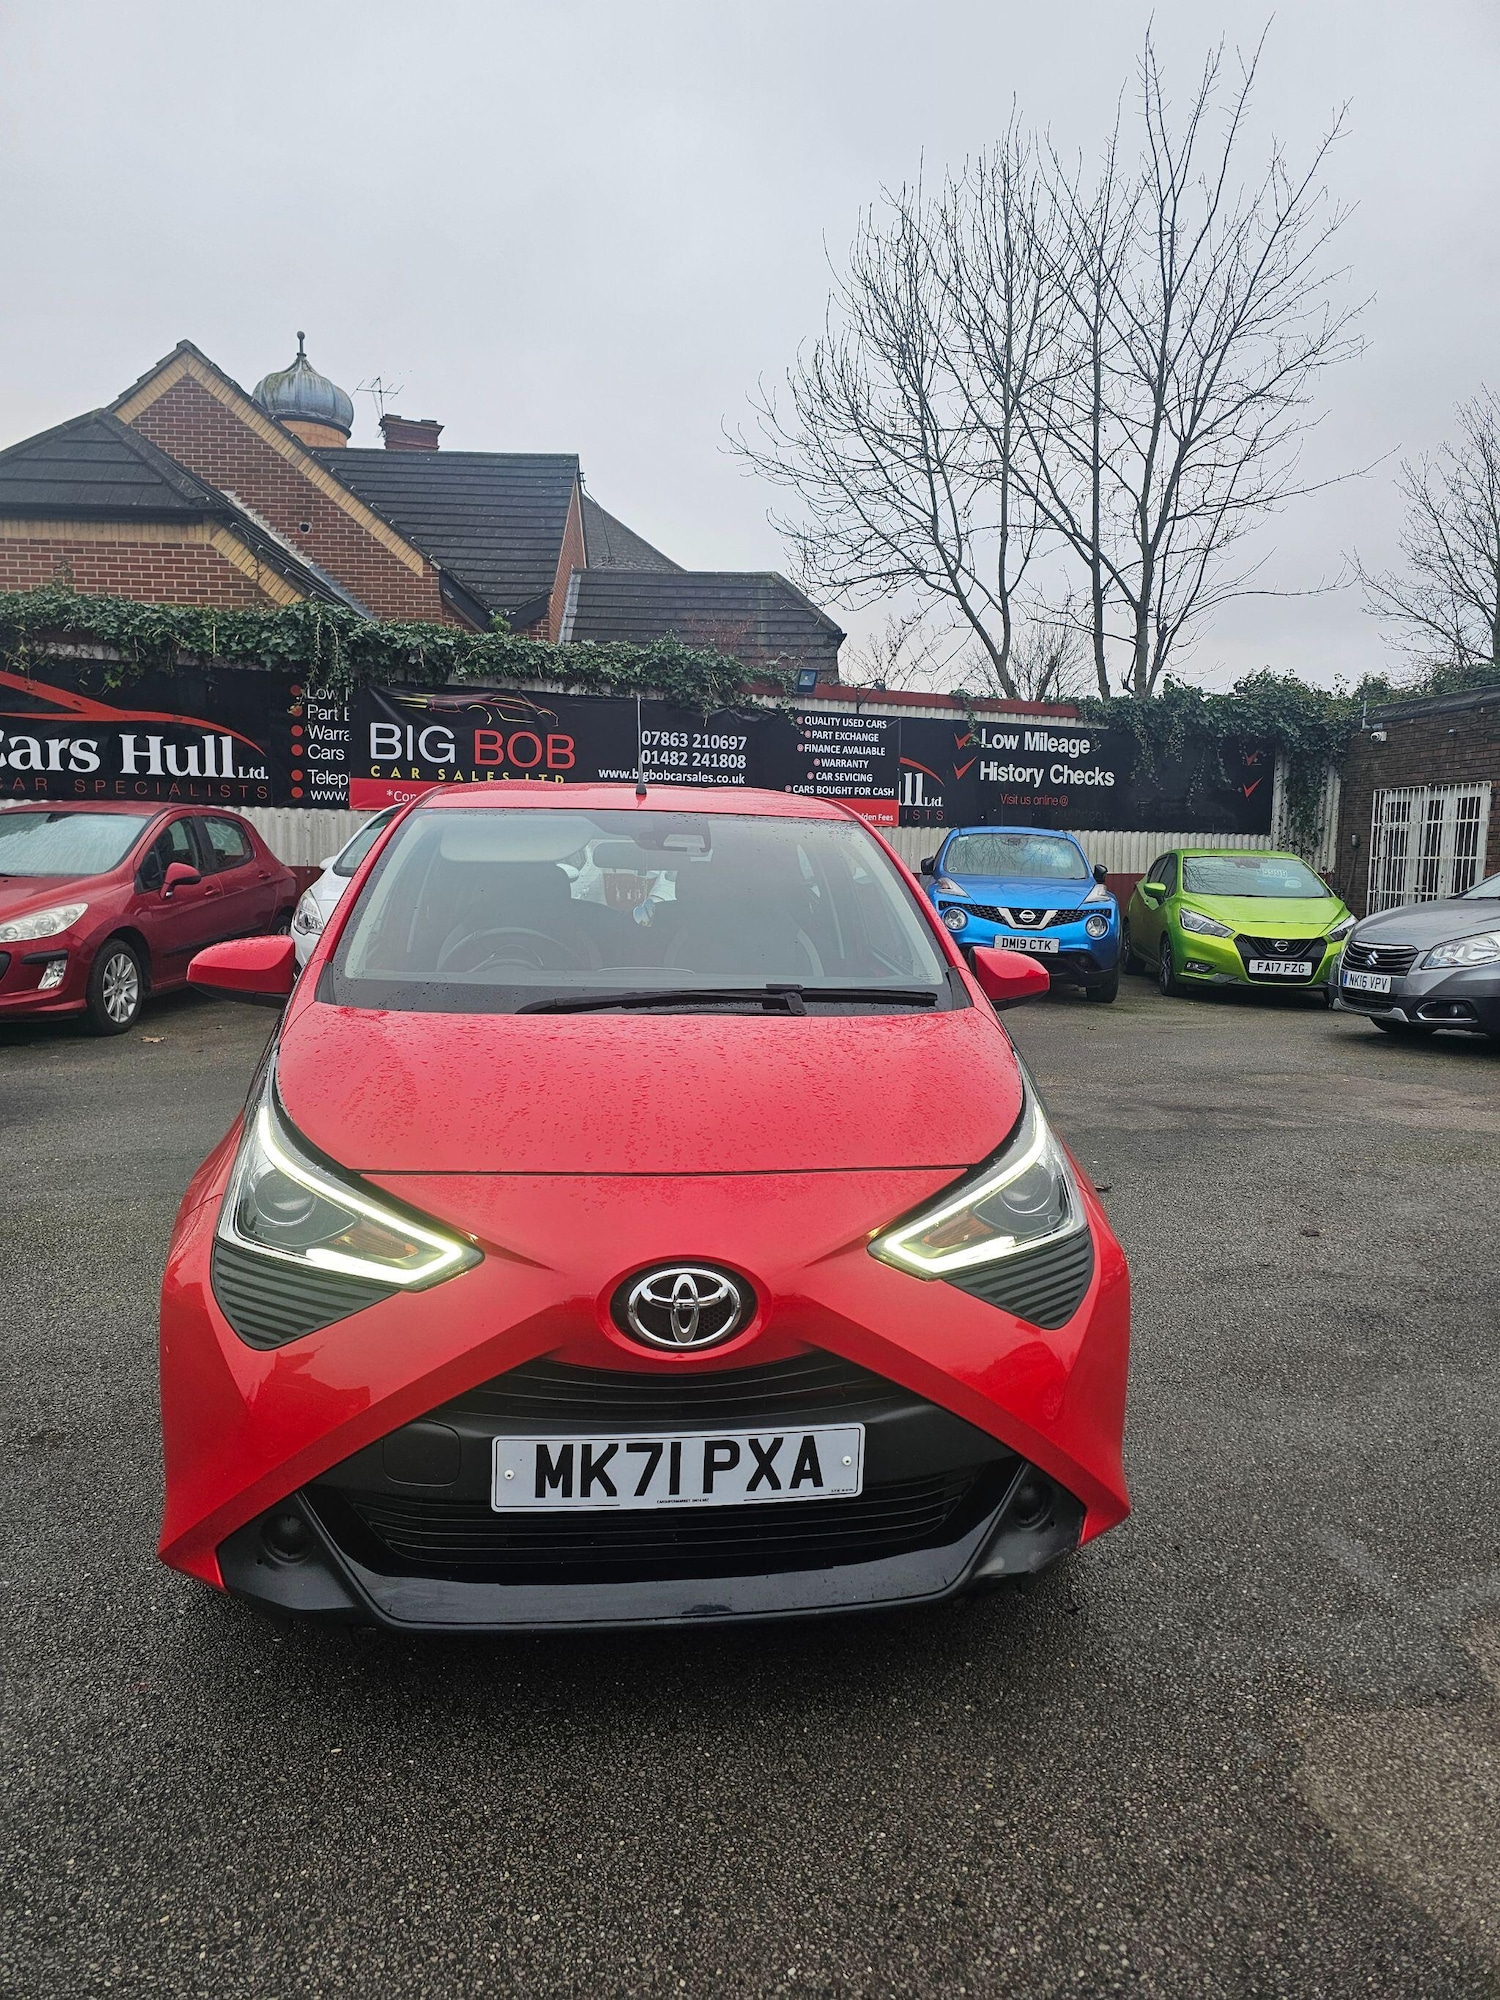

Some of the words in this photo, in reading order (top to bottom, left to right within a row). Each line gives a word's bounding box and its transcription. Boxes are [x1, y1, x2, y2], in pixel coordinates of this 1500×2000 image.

[307, 704, 338, 721] Part
[804, 716, 840, 726] QUALITY
[842, 718, 864, 728] USED
[865, 719, 887, 729] CARS
[641, 730, 688, 747] 07863
[692, 733, 747, 750] 210697
[812, 731, 833, 739] PART
[835, 732, 879, 742] EXCHANGE
[981, 728, 1019, 750] Low
[1024, 731, 1090, 759] Mileage
[307, 744, 345, 761] Cars
[370, 722, 455, 764] BIG
[474, 729, 576, 769] BOB
[804, 744, 840, 754] FINANCE
[842, 746, 885, 756] AVALIABLE
[0, 730, 101, 773] ars
[119, 733, 236, 778] Hull
[238, 766, 269, 780] Ltd.
[641, 750, 688, 766] 01482
[692, 752, 747, 769] 241808
[821, 758, 869, 768] WARRANTY
[370, 765, 420, 779] CAR
[598, 768, 745, 784] www.bgbobcarsales.co.uk
[816, 772, 833, 781] CAR
[835, 773, 873, 782] SEVICING
[980, 760, 1044, 788] History
[1050, 764, 1115, 787] Checks
[0, 777, 48, 791] AR
[74, 779, 268, 799] SPECIALISTS
[793, 785, 814, 794] CARS
[816, 786, 853, 795] BOUGHT
[854, 787, 871, 796] FOR
[873, 787, 895, 797] CASH
[1000, 793, 1018, 805] Visit
[1020, 797, 1031, 805] us
[1033, 795, 1058, 806] online
[878, 813, 893, 821] Fees
[1002, 938, 1027, 949] DM19
[1029, 940, 1052, 951] CTK
[1257, 962, 1281, 971] FA17
[1284, 963, 1305, 973] FZG
[1348, 973, 1367, 988] NK16
[1370, 976, 1388, 991] VPV
[535, 1441, 682, 1498] MK71
[702, 1435, 824, 1494] PXA
